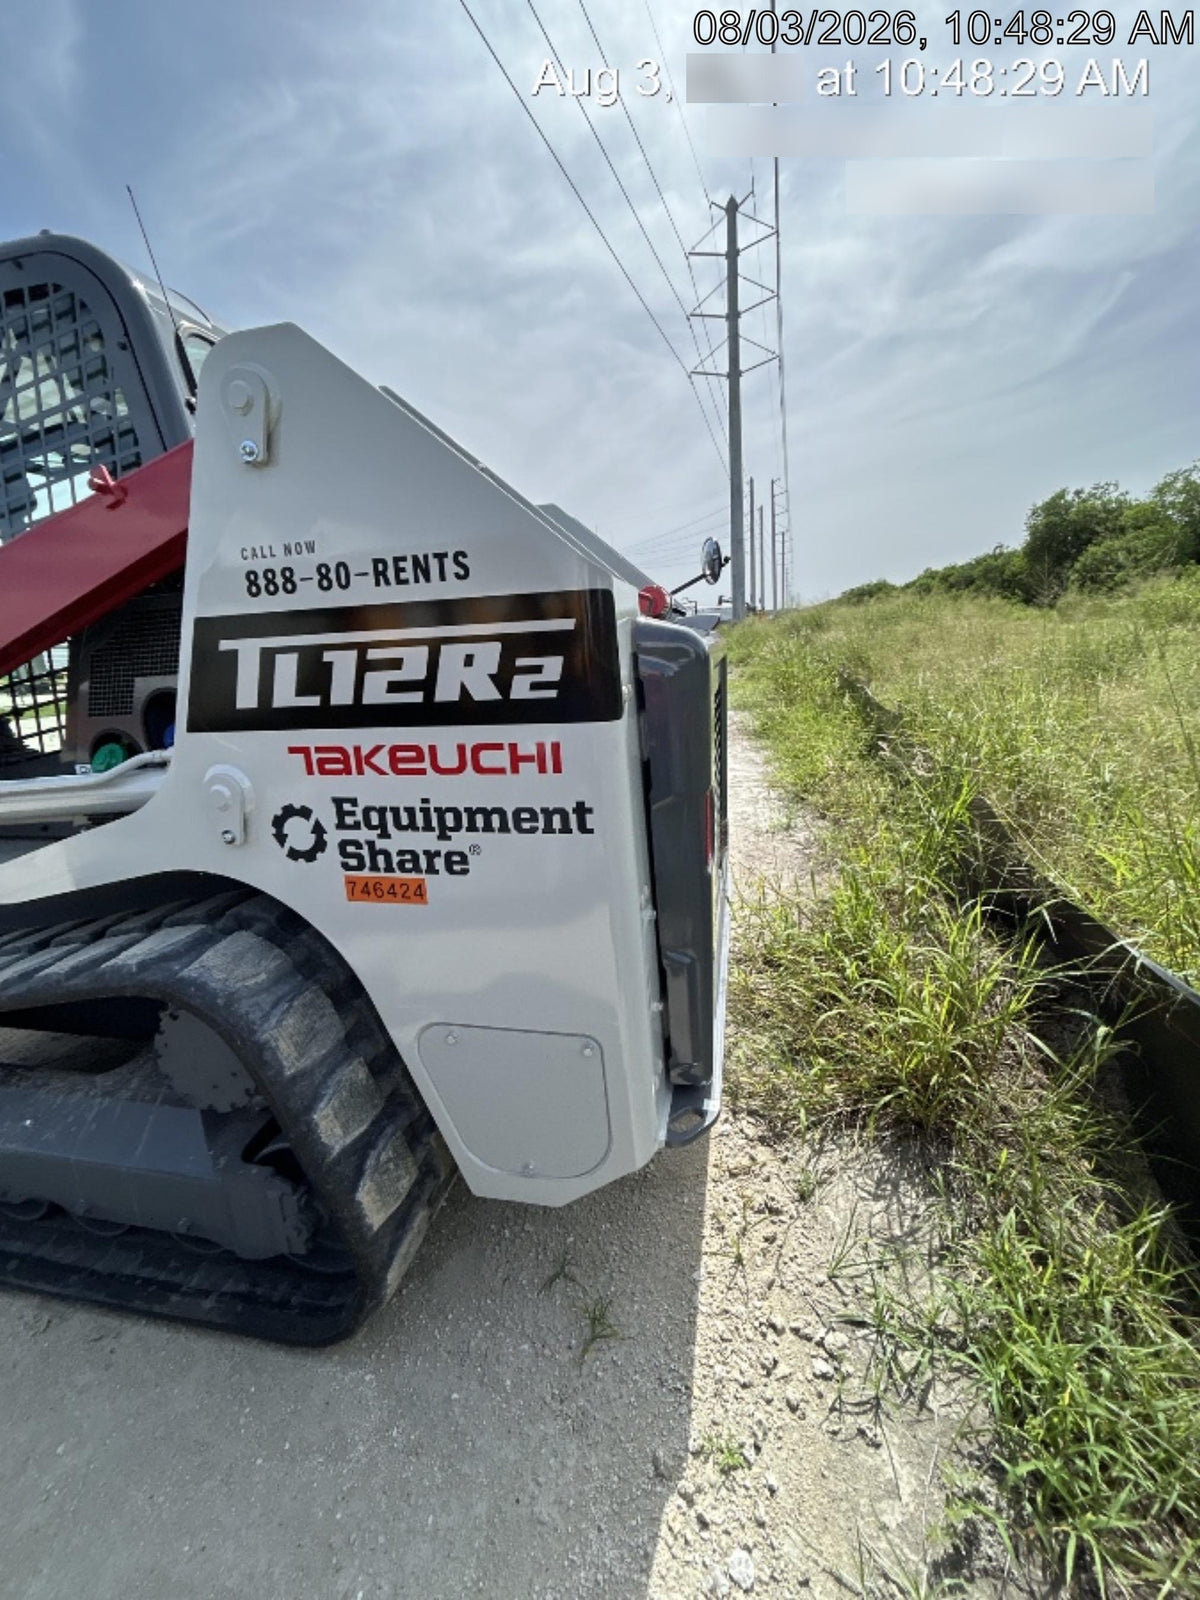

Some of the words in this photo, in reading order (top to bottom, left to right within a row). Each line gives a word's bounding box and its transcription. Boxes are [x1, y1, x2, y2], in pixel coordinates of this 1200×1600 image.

[240, 545, 277, 561] CALL
[283, 540, 317, 558] NOW
[245, 550, 471, 598] 888-80-RENTS
[331, 796, 595, 842] Equipment
[347, 880, 425, 900] 746424
